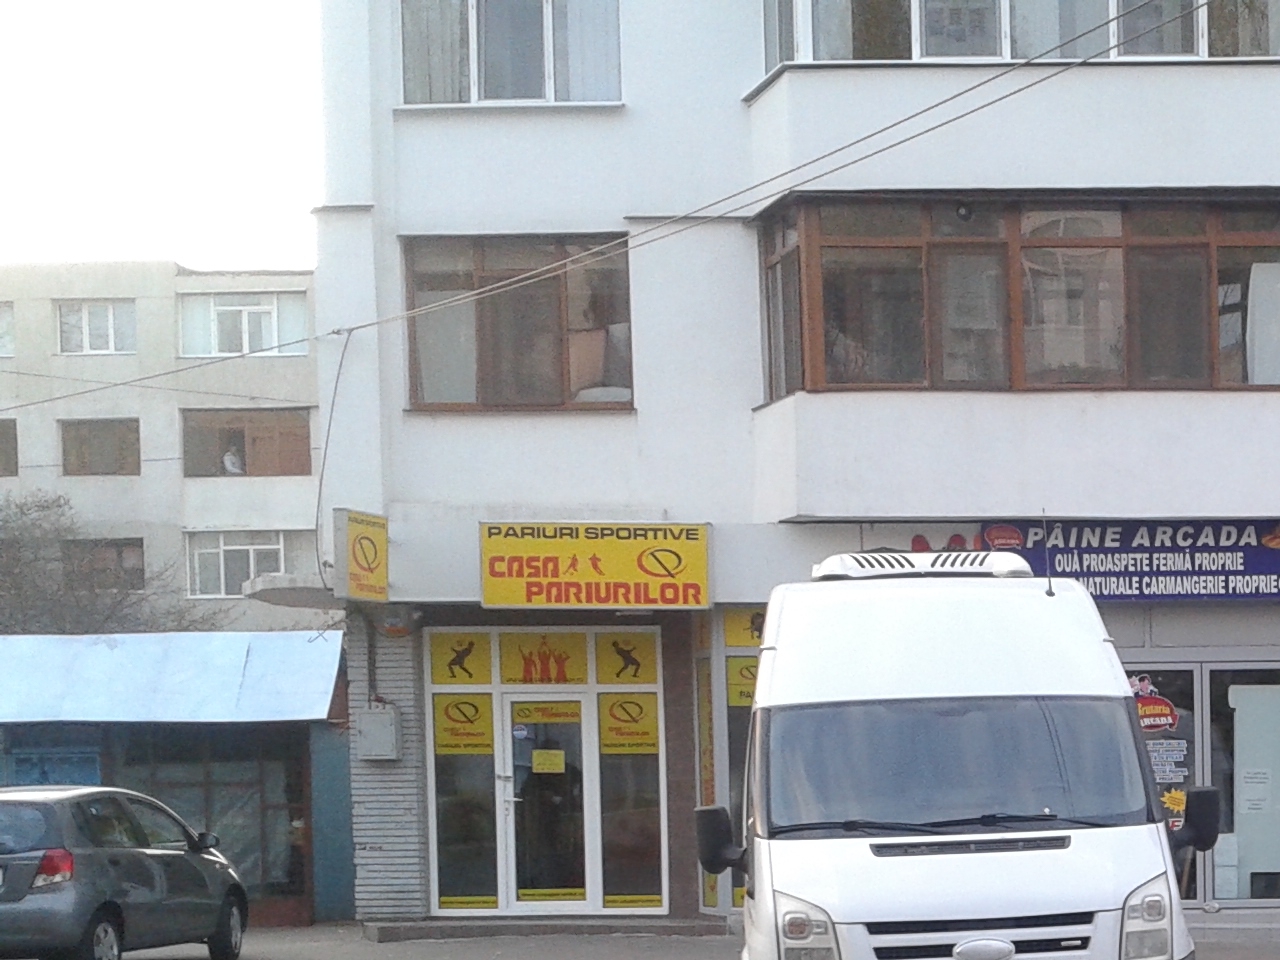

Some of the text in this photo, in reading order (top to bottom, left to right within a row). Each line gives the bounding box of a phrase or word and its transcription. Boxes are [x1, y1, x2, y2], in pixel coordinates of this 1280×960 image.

[487, 526, 700, 541] PARIURI SPORTIVE
[1026, 522, 1258, 549] PÂINE ARCADA
[488, 555, 560, 579] CASA
[1083, 552, 1150, 573] PROASPETE
[1152, 548, 1192, 572] FERMĂ
[1194, 551, 1245, 571] PROPRIE
[525, 581, 702, 605] PARIURILOR
[1142, 575, 1226, 595] CARMANGERIE
[1228, 574, 1279, 594] PROPRIE
